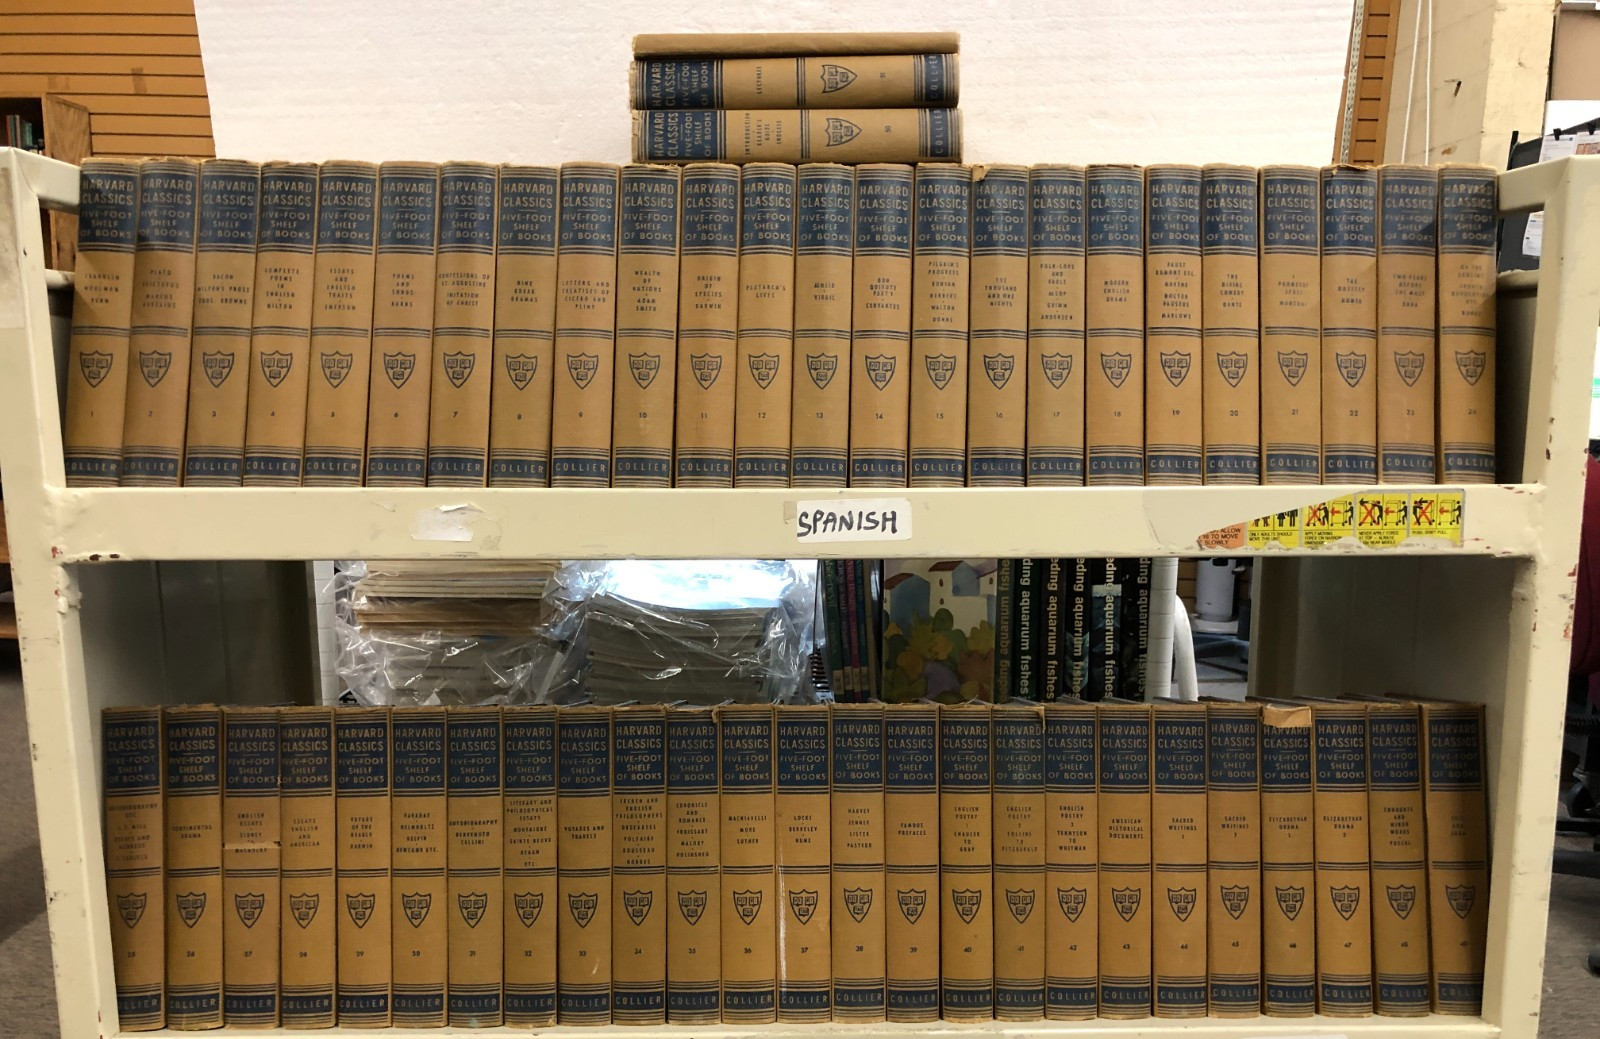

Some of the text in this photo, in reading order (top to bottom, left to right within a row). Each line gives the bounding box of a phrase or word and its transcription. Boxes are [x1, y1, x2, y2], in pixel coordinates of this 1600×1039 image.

[929, 56, 938, 98] COLLIER
[652, 63, 661, 106] HARVARD
[665, 63, 675, 106] CLASSICS
[702, 94, 708, 105] OF
[654, 113, 664, 156] HARVARD
[668, 113, 678, 156] CLASSICS
[934, 110, 943, 153] COLLIER
[705, 146, 711, 156] OF
[83, 180, 133, 191] HARVARD
[264, 181, 312, 193] HARVARD
[504, 183, 552, 195] HARVARD
[625, 183, 674, 195] HARVARD
[802, 184, 849, 195] HARVARD
[1034, 185, 1082, 196] HARVARD
[1152, 184, 1200, 196] HARVARD
[1326, 185, 1374, 196] HARVARD
[82, 193, 133, 206] CLASSICS
[263, 195, 311, 207] CLASSICS
[503, 196, 552, 208] CLASSICS
[624, 196, 673, 208] CLASSICS
[802, 198, 849, 209] CLASSICS
[1033, 198, 1082, 210] CLASSICS
[1152, 198, 1200, 210] CLASSICS
[1326, 198, 1373, 209] CLASSICS
[503, 214, 552, 222] FIVE-FOOT
[1033, 215, 1081, 223] FIVE-FOOT
[1045, 224, 1070, 232] SHELF
[517, 233, 552, 241] BOOKS
[1049, 234, 1081, 242] BOOKS
[246, 462, 296, 471] COLLIER
[556, 463, 605, 472] COLLIER
[739, 463, 786, 472] COLLIER
[1151, 460, 1199, 468] COLLIER
[1328, 460, 1375, 469] COLLIER
[797, 510, 897, 537] SPANISH
[1000, 559, 1010, 591] fishe
[1020, 590, 1031, 650] aquarium
[1137, 590, 1148, 648] aquarium
[1047, 596, 1058, 698] aquarium fishes
[1073, 597, 1084, 699] aquarium fishes
[1104, 595, 1115, 698] aquarium fishes
[1020, 655, 1031, 694] fishes
[1137, 654, 1147, 696] fishes
[169, 727, 215, 738] HARVARD
[338, 728, 384, 738] HARVARD
[617, 726, 662, 736] HARVARD
[780, 726, 825, 736] HARVARD
[1048, 725, 1093, 736] HARVARD
[1318, 725, 1364, 735] HARVARD
[169, 740, 215, 750] CLASSICS
[338, 741, 384, 751] CLASSICS
[617, 739, 662, 749] CLASSICS
[780, 739, 825, 749] CLASSICS
[1048, 738, 1093, 749] CLASSICS
[1318, 737, 1364, 748] CLASSICS
[617, 755, 662, 763] FIVE-FOOT
[631, 772, 662, 780] BOOKS
[1063, 772, 1094, 780] BOOKS
[836, 994, 882, 1002] COLLIER
[1050, 992, 1095, 1001] COLLIER
[1324, 989, 1369, 998] COLLIER
[340, 999, 385, 1008] COLLIER
[616, 996, 661, 1005] COLLIER
